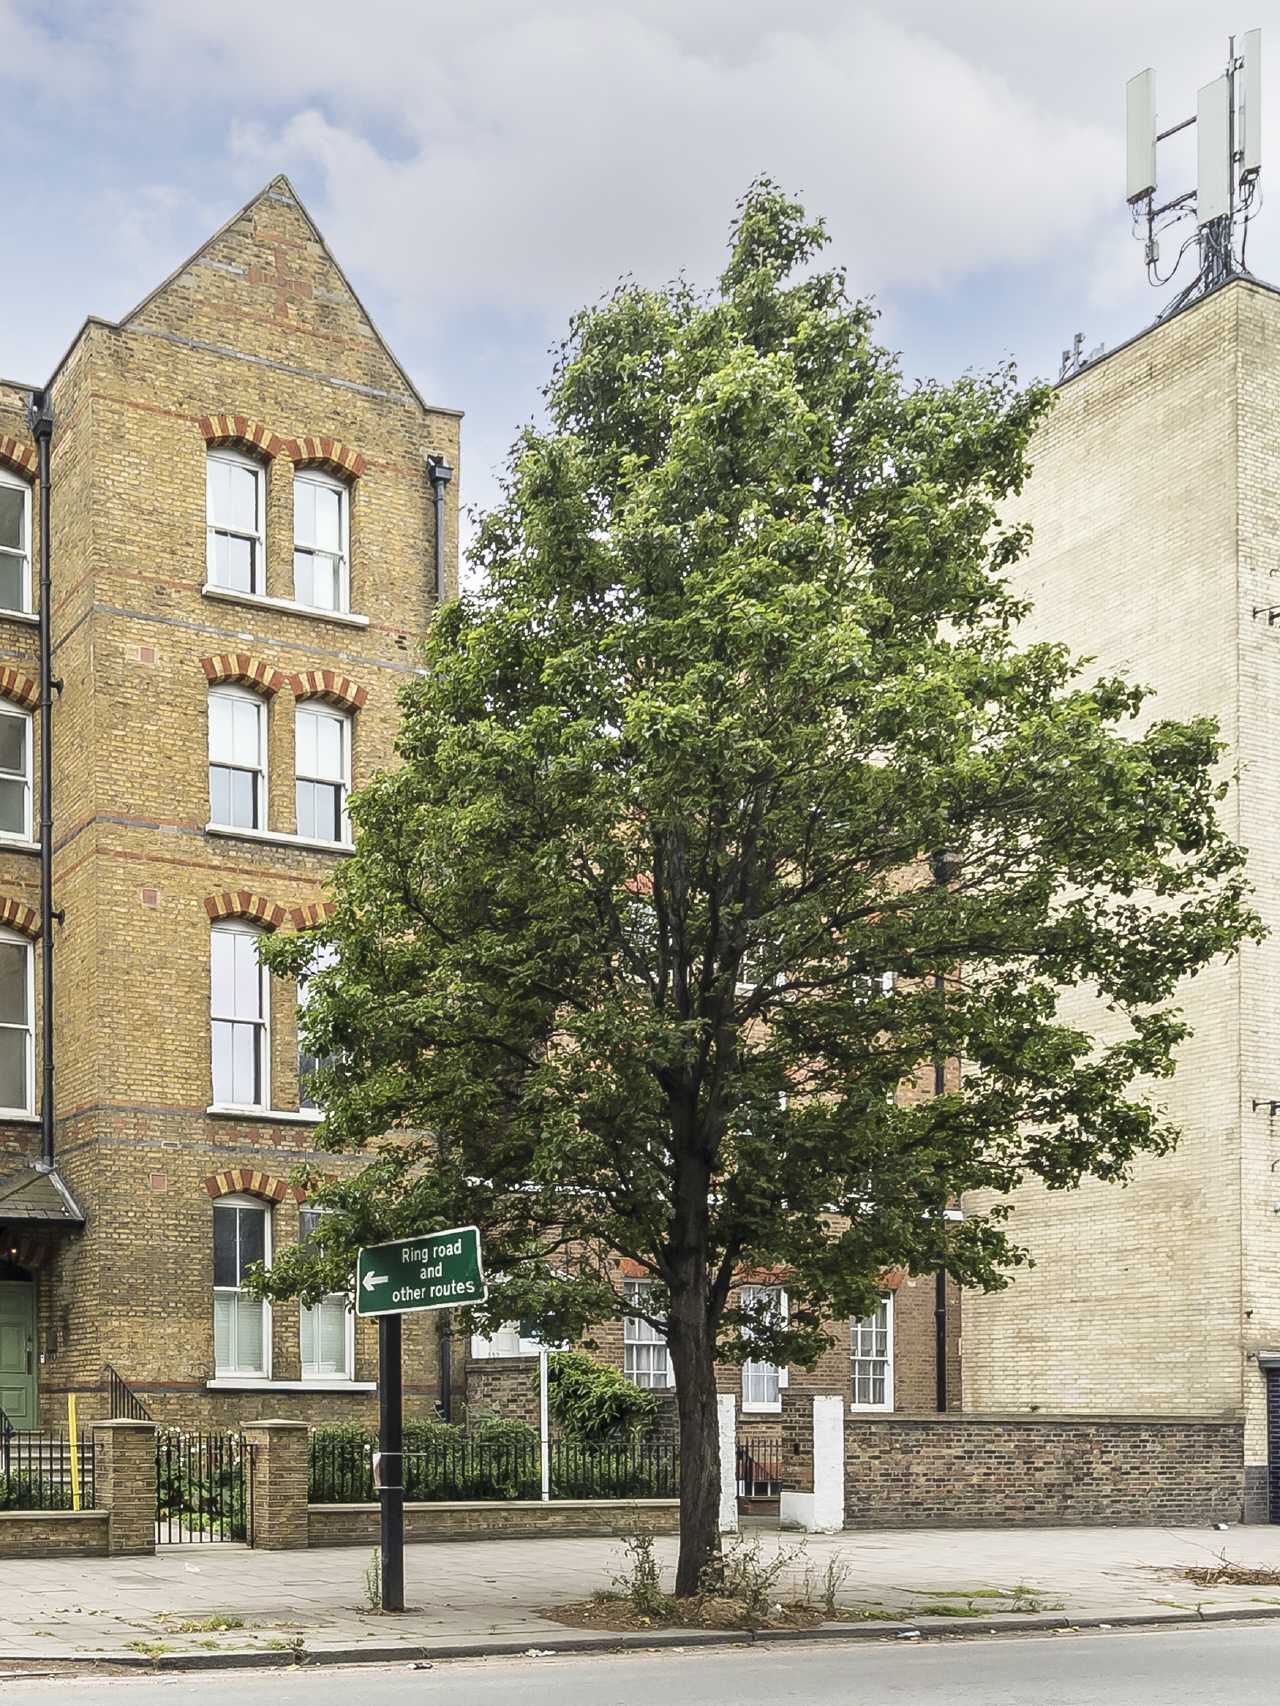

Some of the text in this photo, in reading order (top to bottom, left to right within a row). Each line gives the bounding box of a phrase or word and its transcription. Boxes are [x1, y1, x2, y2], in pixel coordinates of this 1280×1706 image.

[402, 1239, 462, 1263] Ring road
[420, 1262, 443, 1280] and
[392, 1279, 475, 1302] other routes
